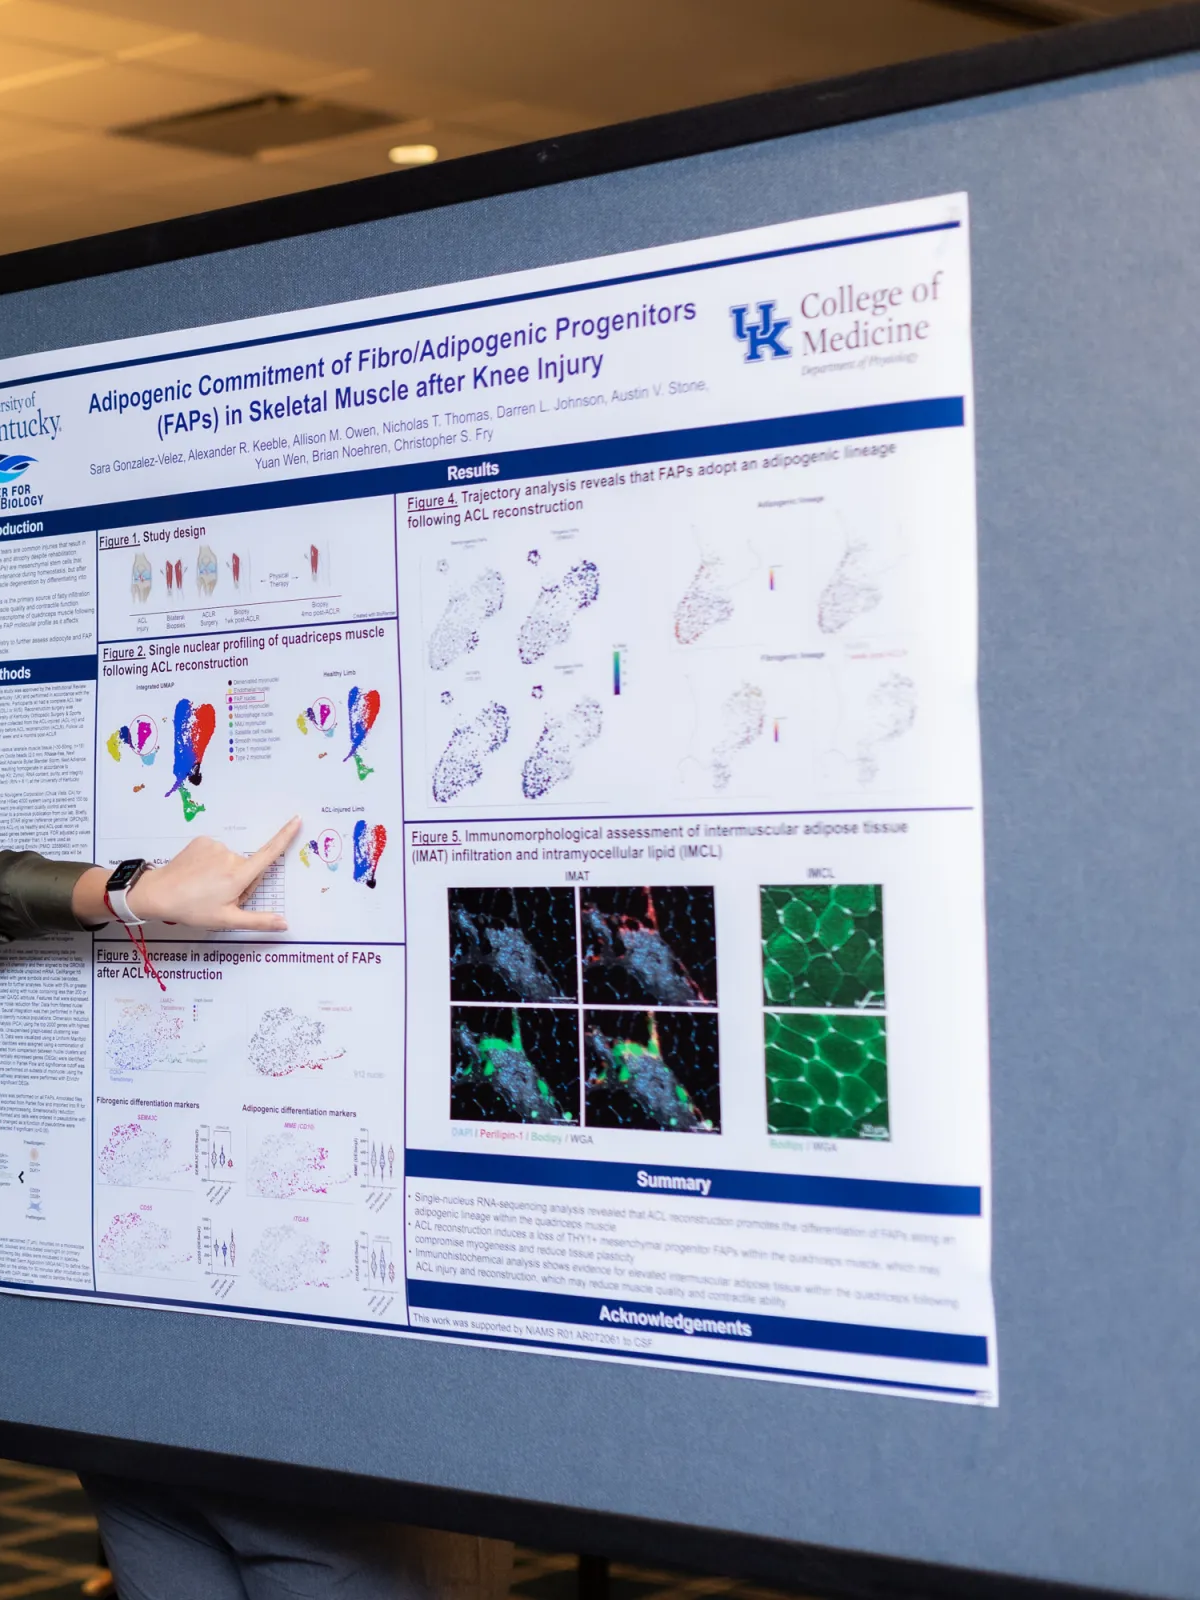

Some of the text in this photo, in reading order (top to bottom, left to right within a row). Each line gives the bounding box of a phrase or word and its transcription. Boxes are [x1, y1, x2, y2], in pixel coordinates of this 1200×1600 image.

[802, 270, 944, 318] College of
[802, 318, 929, 356] Medicine
[89, 302, 696, 414] Adipogenic Commitment of Fibro/Adipogenic Progenitors
[25, 391, 36, 408] of
[158, 354, 604, 442] (FAPs) in Skeletal Muscle after Knee Injury
[90, 463, 110, 474] Sara
[113, 451, 185, 470] Gonzalez-Velez,
[188, 443, 236, 459] Alexander
[239, 440, 250, 451] R.
[253, 435, 289, 449] Keeble,
[292, 431, 326, 444] Allison
[329, 427, 342, 438] M.
[345, 424, 380, 436] Owen,
[382, 416, 429, 431] Nicholas
[432, 413, 441, 425] T.
[444, 410, 493, 423] Thomas,
[496, 404, 536, 416] Darren
[539, 400, 550, 411] L.
[553, 396, 607, 409] Johnson,
[610, 388, 649, 402] Austin
[652, 386, 664, 397] V.
[255, 429, 493, 469] Yuan Wen, Brian Noehren, Christopher S. Fry
[408, 444, 896, 511] Figure 4. Trajectory analysis reveals that FAPs adopt an adipogenic lineage
[448, 462, 499, 480] Results
[12, 484, 30, 496] FOR
[0, 495, 44, 509] BIOLOGY
[408, 499, 583, 527] following ACL reconstruction
[100, 526, 205, 548] Figure 1. Study design
[103, 627, 384, 660] Figure 2. Single nuclear profiling of quadriceps muscle
[103, 657, 248, 676] following ACL reconstruction
[413, 821, 907, 846] Figure 5. Immunomorphological assessment of intermuscular adipose tissue
[413, 845, 722, 864] (IMAT) infiltration and intramyocellular lipid (IMCL)
[566, 871, 590, 881] IMAT
[97, 950, 381, 965] Figure 3. ncrease in adipogenic commitment of FAPs
[97, 967, 119, 978] after
[122, 968, 142, 978] ACL
[97, 1097, 128, 1106] Fibrogenic
[130, 1098, 172, 1107] differentiation
[242, 1104, 356, 1117] Adipogenic differentiation markers
[570, 1134, 593, 1144] WGA
[637, 1170, 711, 1195] Summary
[414, 1314, 429, 1324] This
[431, 1317, 450, 1326] work
[452, 1320, 468, 1328] was
[470, 1322, 511, 1332] supported
[513, 1324, 523, 1335] by
[600, 1305, 752, 1336] Acknowledgements
